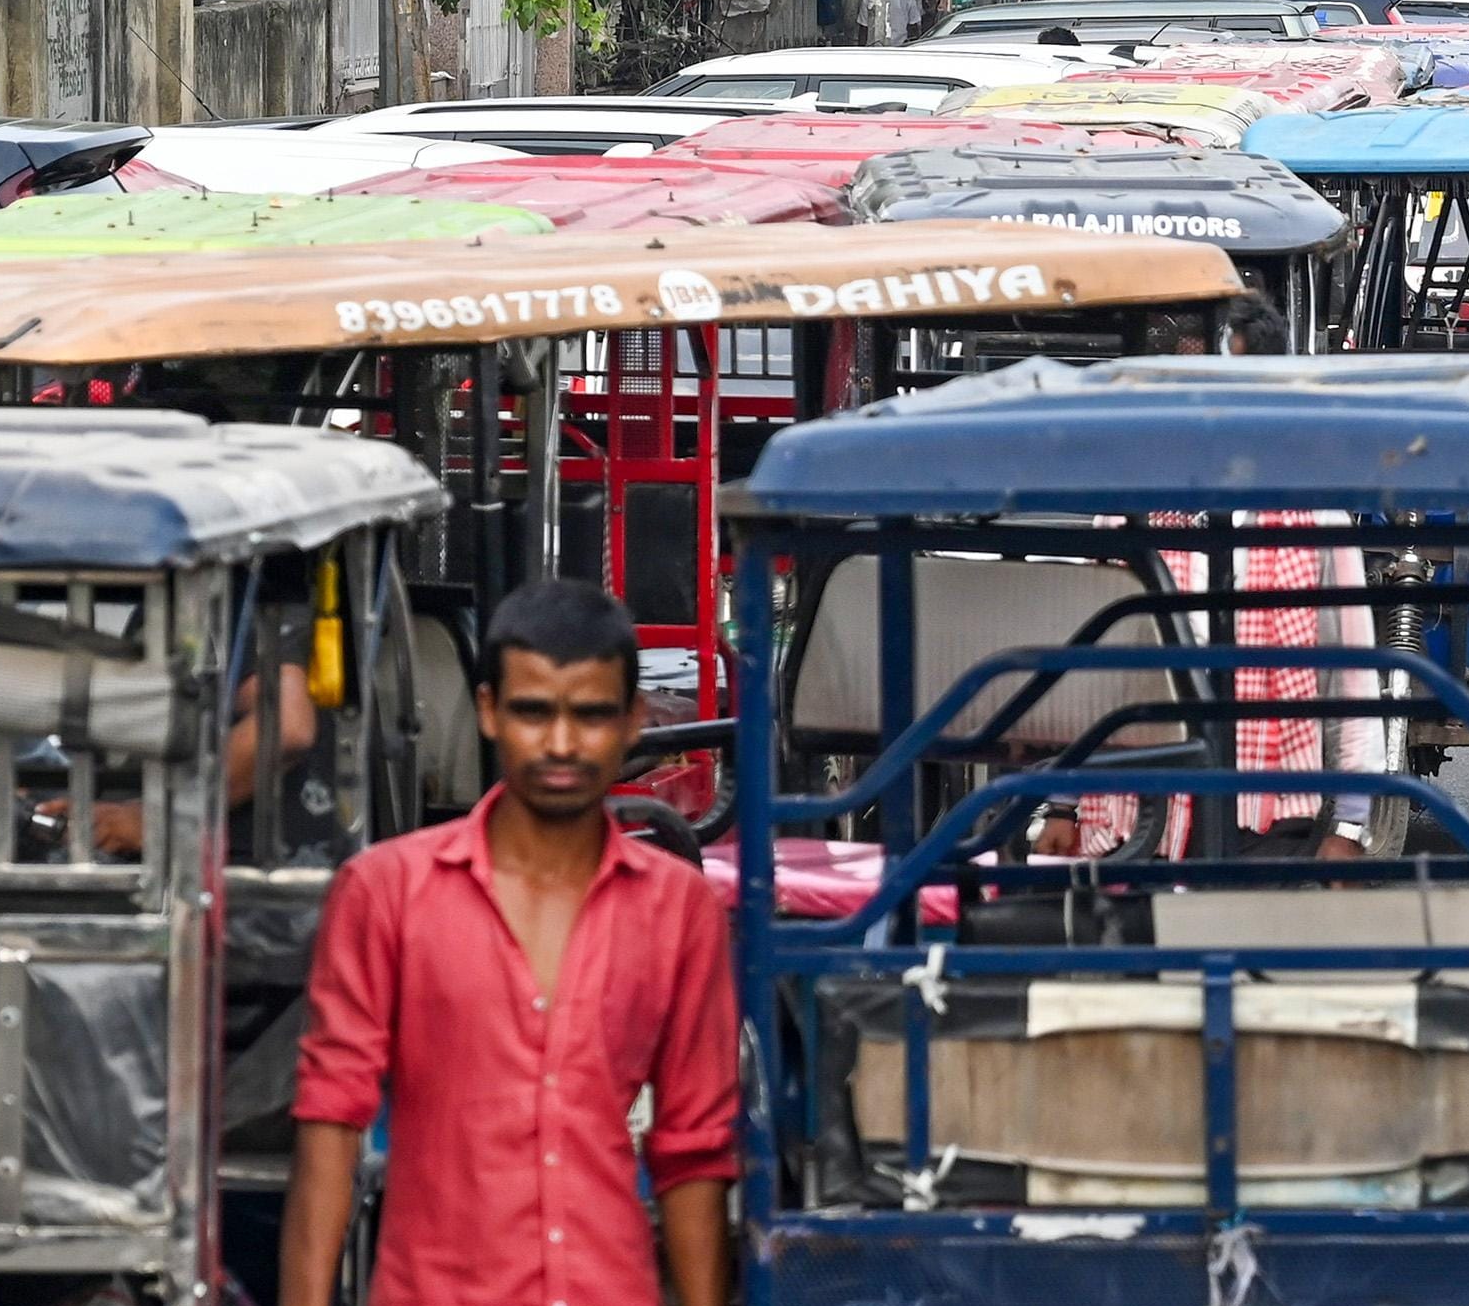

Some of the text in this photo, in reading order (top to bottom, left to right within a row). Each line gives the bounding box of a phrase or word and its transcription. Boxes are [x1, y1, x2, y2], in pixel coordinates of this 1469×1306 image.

[1132, 215, 1244, 238] MOTORS
[334, 283, 625, 333] 8396817778
[782, 264, 1048, 316] DAHIYA
